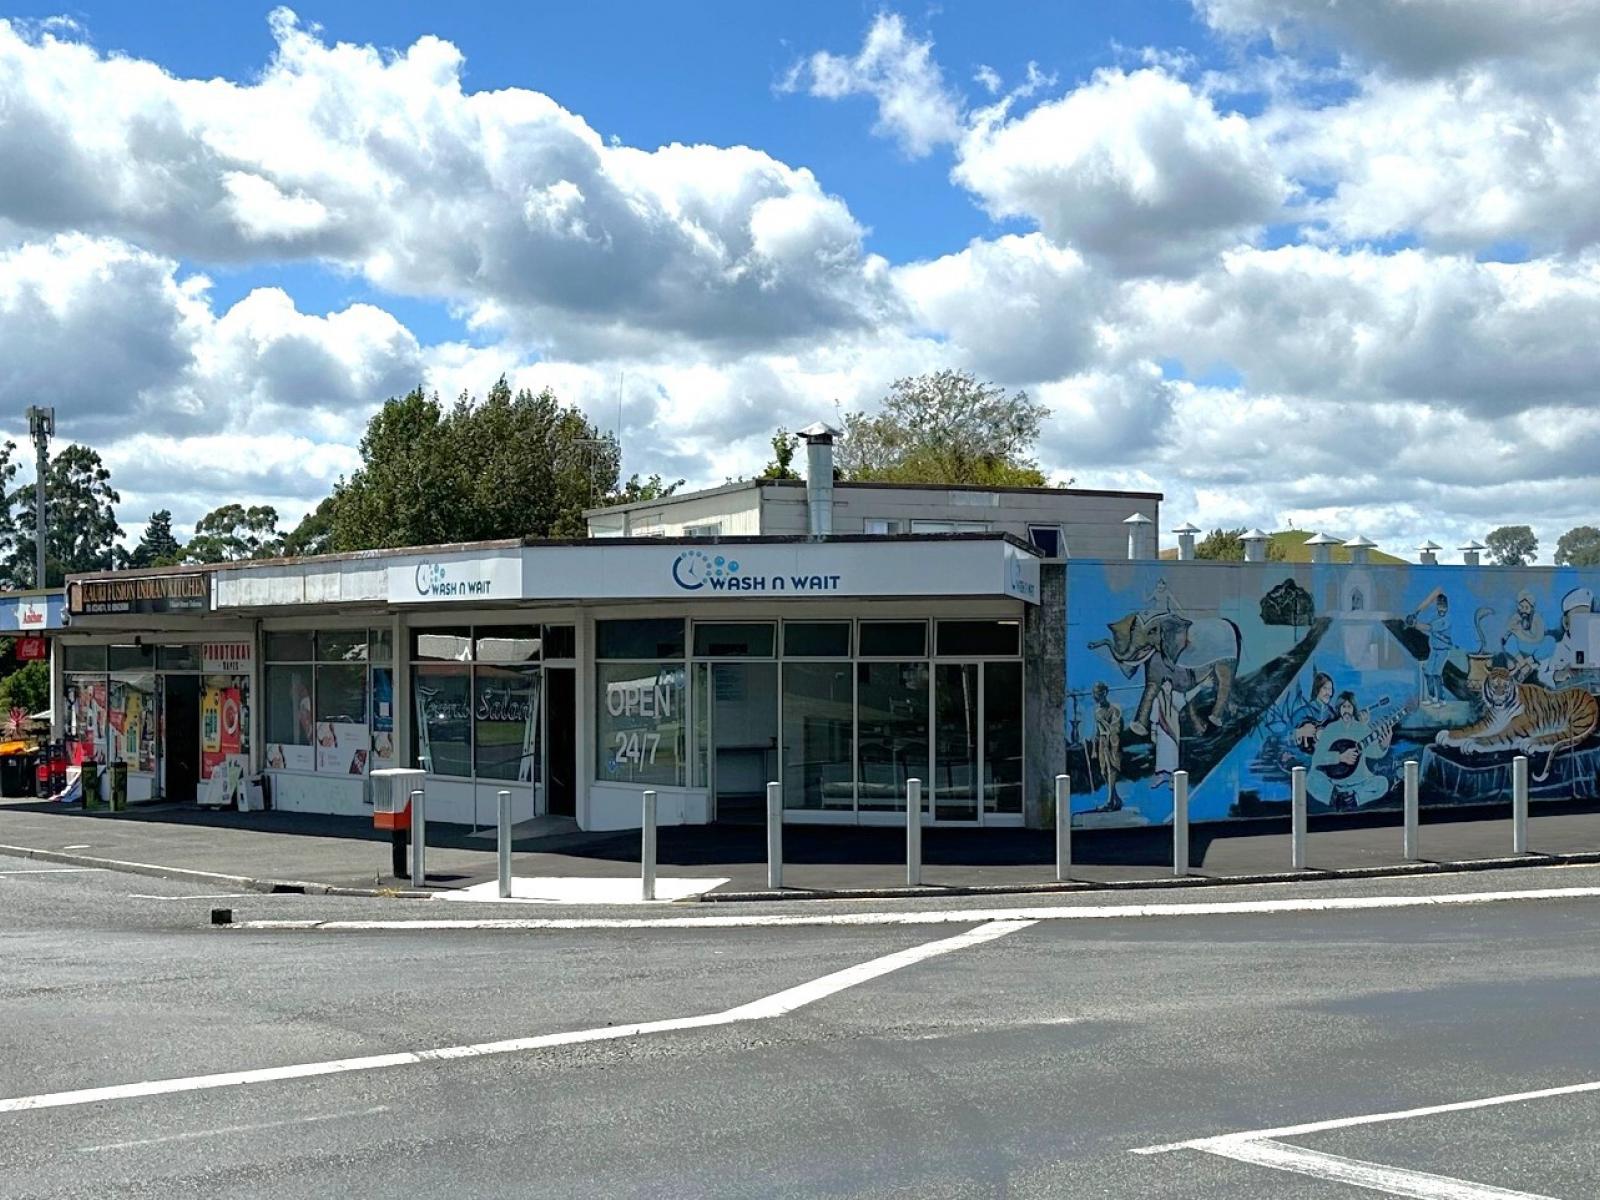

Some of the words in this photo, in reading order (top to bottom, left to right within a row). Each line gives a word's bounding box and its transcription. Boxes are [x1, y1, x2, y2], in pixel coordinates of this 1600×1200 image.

[107, 581, 136, 602] FUSION
[137, 579, 167, 600] INDIAN
[167, 576, 207, 598] KITCHEN
[432, 582, 457, 595] WASH
[468, 580, 491, 594] WAIT
[710, 576, 765, 591] WASH
[791, 576, 840, 589] WAIT
[607, 685, 671, 717] OPEN
[615, 732, 661, 772] 24/7
